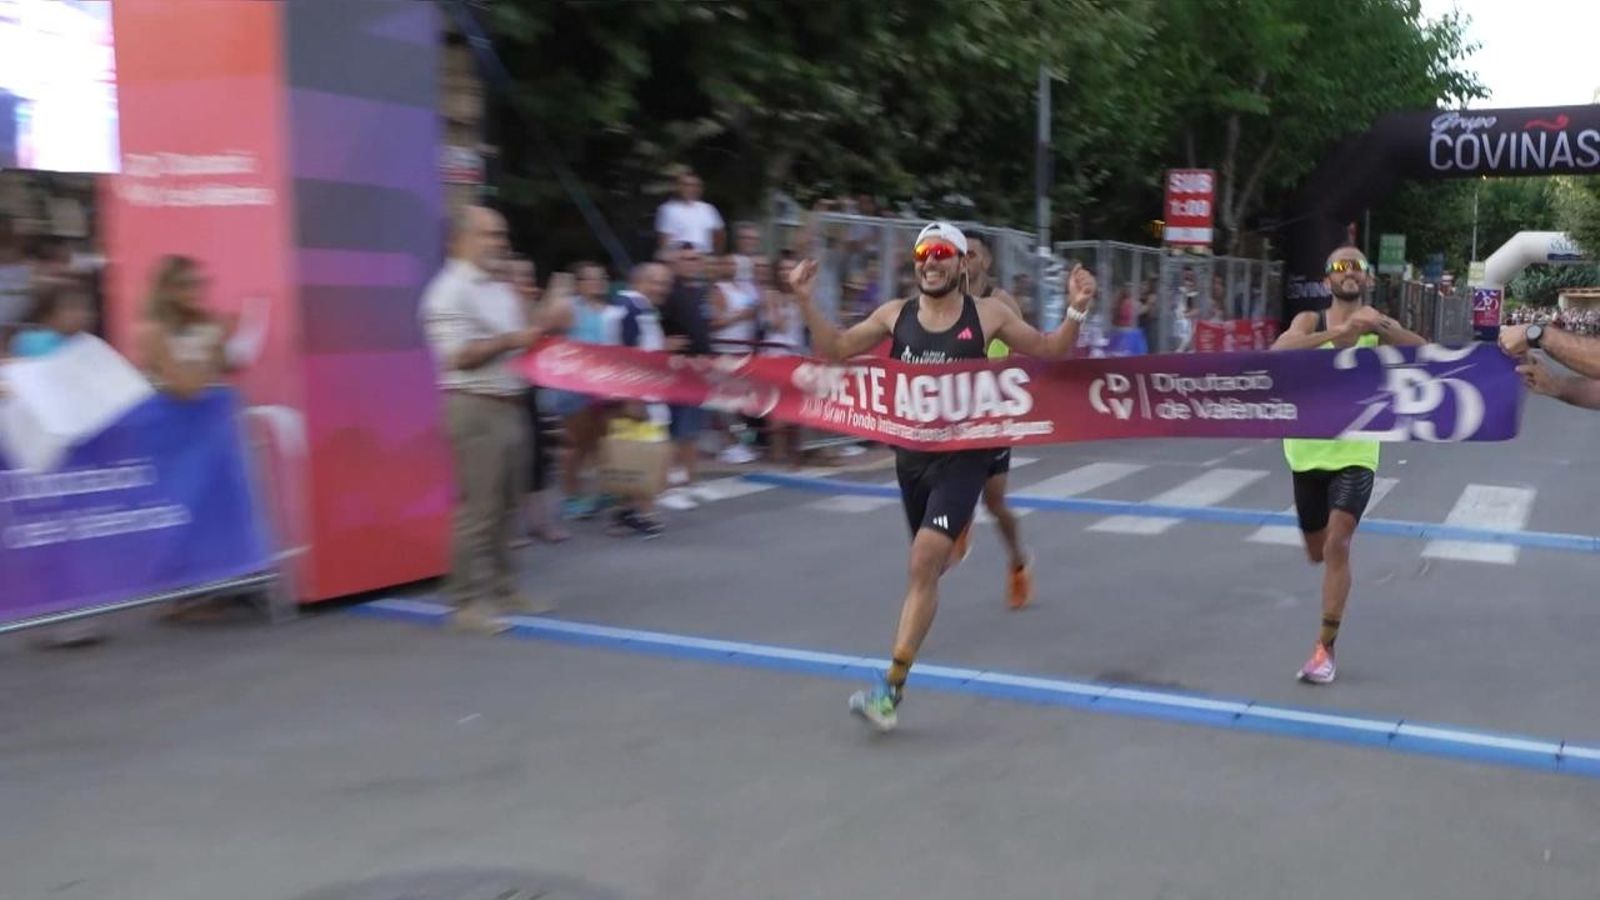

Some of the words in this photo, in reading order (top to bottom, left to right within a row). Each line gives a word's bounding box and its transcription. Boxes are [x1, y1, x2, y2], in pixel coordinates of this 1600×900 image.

[1169, 173, 1212, 194] SUB
[894, 368, 1033, 424] AGUAS
[847, 406, 877, 431] Fondo
[1155, 399, 1191, 420] de
